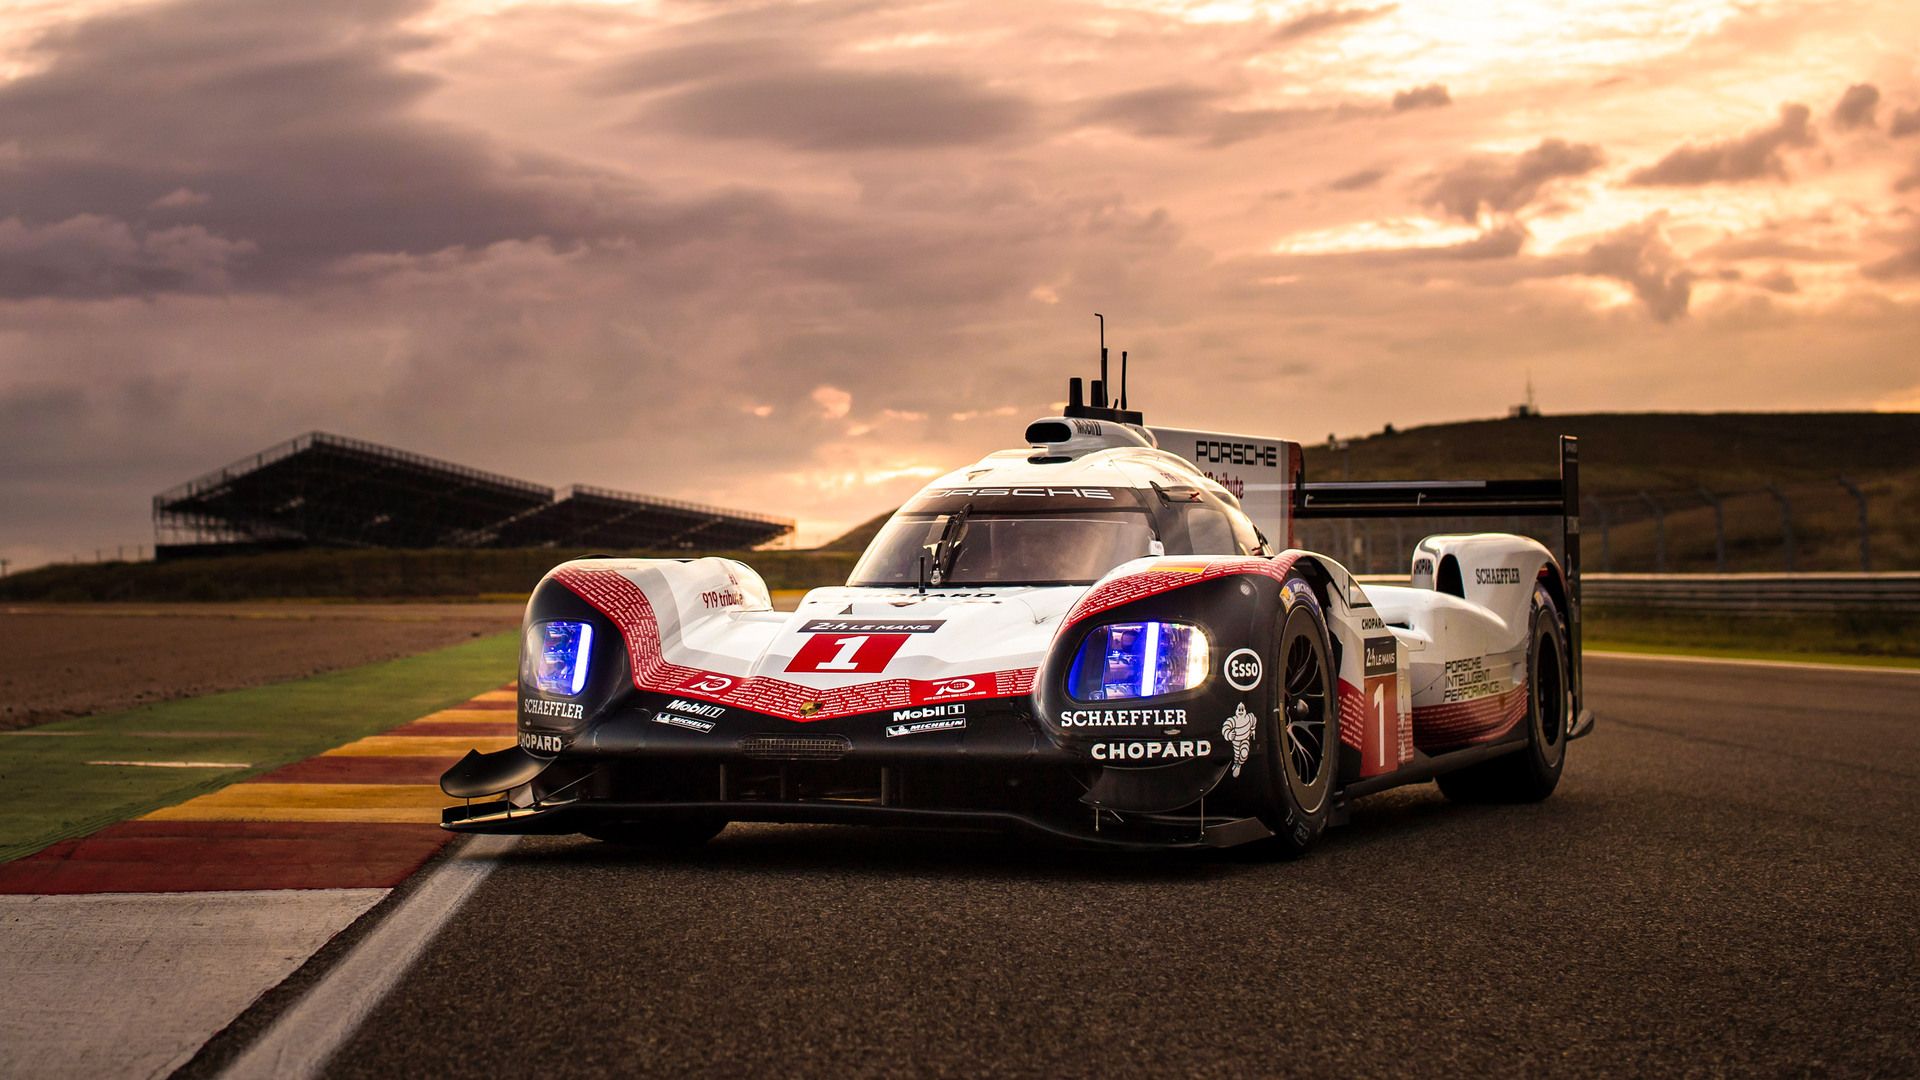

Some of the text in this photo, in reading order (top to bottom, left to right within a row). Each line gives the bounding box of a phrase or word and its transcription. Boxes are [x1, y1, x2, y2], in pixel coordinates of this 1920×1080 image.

[1196, 440, 1277, 467] PORSCHE
[1475, 567, 1520, 584] SCHAEFFLER
[702, 591, 718, 608] 919
[815, 635, 871, 670] 1
[1445, 656, 1481, 674] PORSCHE
[1445, 668, 1490, 688] INTELLIGENT
[524, 699, 584, 719] SCHAEFFLER
[666, 700, 711, 715] Mobil
[893, 705, 945, 721] Mobil
[671, 717, 712, 729] MICHELIN
[910, 720, 963, 730] MICHELIN
[1060, 709, 1187, 727] SCHAEFFLER
[1374, 683, 1384, 767] 1
[1091, 740, 1211, 759] CHOPARD
